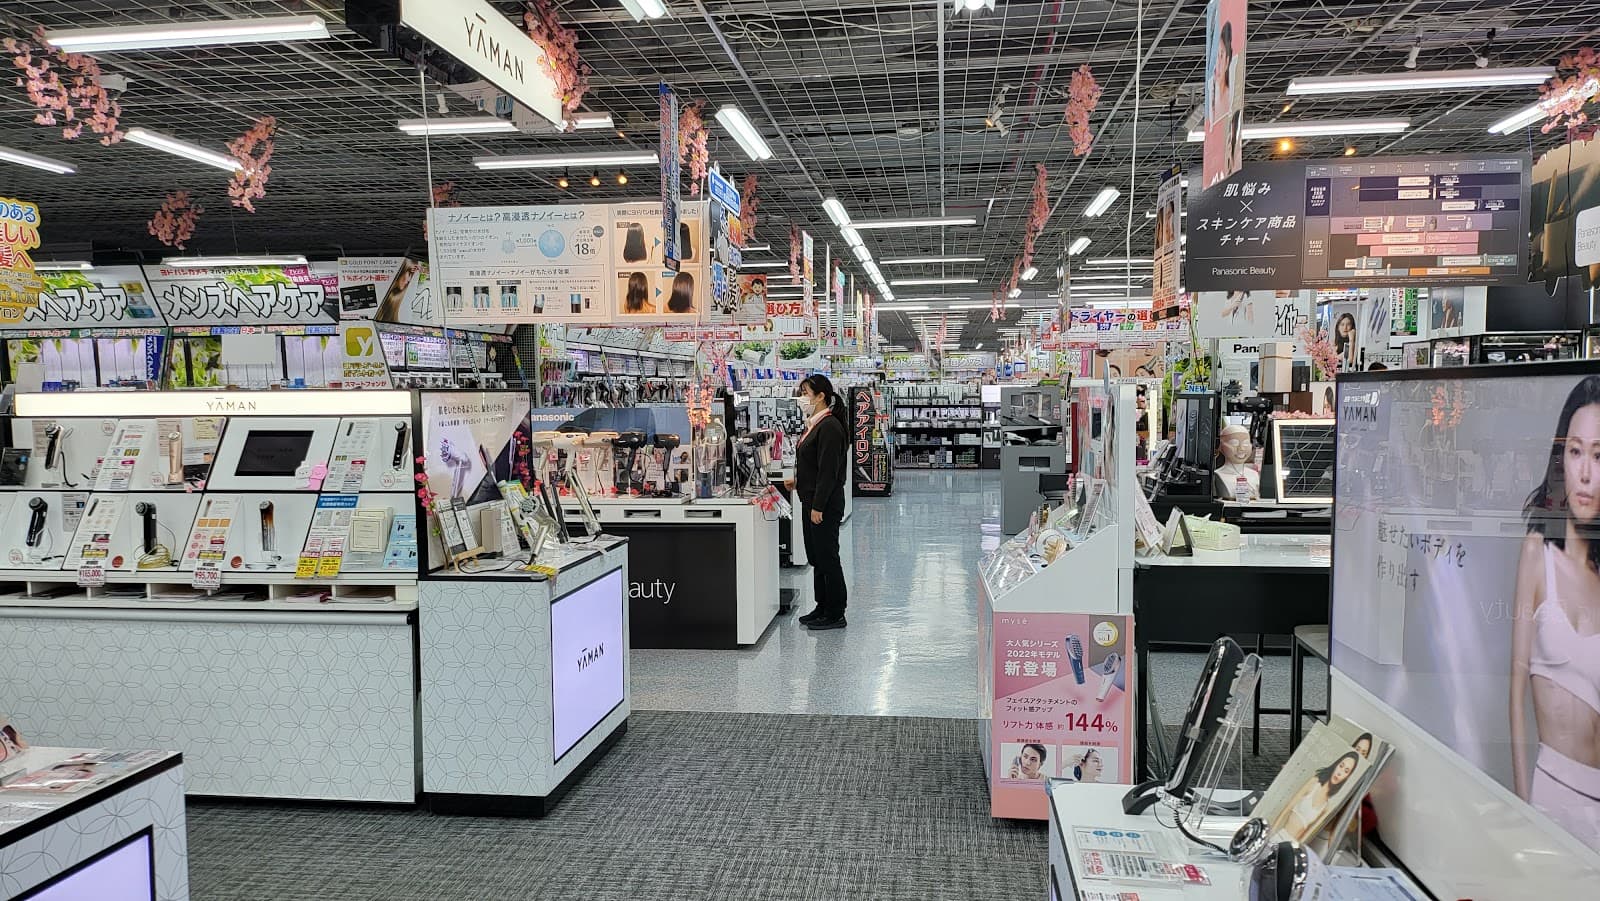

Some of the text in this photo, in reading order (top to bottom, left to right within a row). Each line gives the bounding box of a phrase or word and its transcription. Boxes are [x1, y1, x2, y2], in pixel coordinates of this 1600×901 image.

[1223, 181, 1271, 197] 肌悩み
[1196, 215, 1297, 231] スキンケア商品
[0, 222, 36, 245] しい
[1219, 233, 1272, 246] チャート
[1212, 266, 1277, 276] Panasonic Beauty
[163, 282, 325, 320] メンズヘアケア
[1188, 385, 1208, 393] NEW
[856, 391, 871, 464] ヘアアイロン
[1377, 520, 1466, 567] 魅せたいボディを
[1376, 555, 1420, 591] 作り出す
[1005, 639, 1059, 648] 大人気シリーズ
[1007, 650, 1061, 659] 2022年モデル
[1004, 660, 1057, 677] 新登場
[1006, 697, 1078, 705] フェイスアタッチメントの
[1065, 712, 1118, 732] 144%
